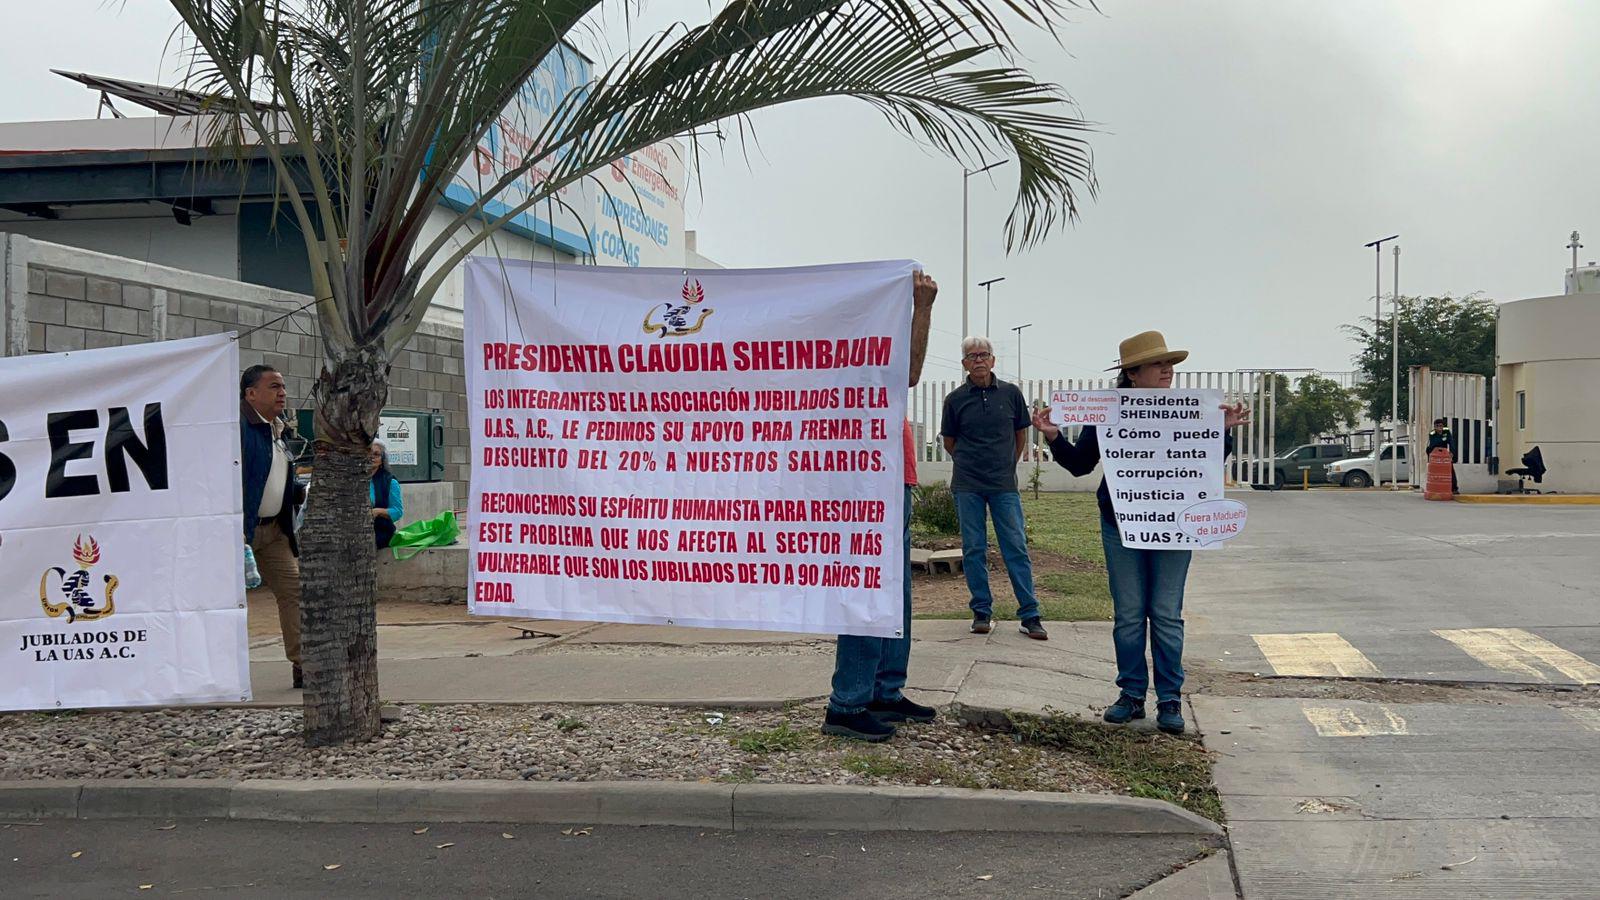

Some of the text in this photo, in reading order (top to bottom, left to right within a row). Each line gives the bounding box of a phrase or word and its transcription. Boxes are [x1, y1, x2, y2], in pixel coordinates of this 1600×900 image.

[602, 192, 669, 246] IMPRESIONES
[601, 230, 640, 267] COPIAS
[483, 336, 892, 373] PRESIDENTA CLAUDIA SHEINBAUM
[484, 387, 888, 412] LOS INTEGRANTES DE LA ASOCIACIÓN JUBILADOS DE LA
[1053, 393, 1079, 402] ALTO
[1120, 395, 1200, 407] Presidenta
[1063, 413, 1106, 423] SALARIO
[484, 418, 519, 440] U.A.S.,
[561, 420, 579, 439] LE
[586, 421, 655, 442] PEDIMOS
[663, 421, 684, 442] SU
[691, 421, 744, 442] APOYO
[752, 421, 792, 441] PARA
[800, 418, 863, 440] FRENAR
[871, 418, 887, 440] EL
[1173, 428, 1220, 442] puede
[45, 401, 169, 499] EN
[1105, 448, 1207, 459] tolerar tanta
[483, 447, 886, 473] DESCUENTO DEL 20% A NUESTROS SALARIOS.
[1116, 468, 1203, 481] corrupción,
[1116, 489, 1207, 503] injusticia e
[481, 492, 885, 523] RECONOCEMOS SU ESPÍRITU HUMANISTA PARA RESOLVER
[1116, 511, 1176, 524] punidad
[1184, 512, 1211, 523] Fuera
[1125, 531, 1135, 542] la
[1197, 523, 1238, 536] de la UAS
[479, 522, 882, 556] ESTE PROBLEMA QUE NOS AFECTA AL SECTOR MÁS
[477, 552, 881, 589] VULNERABLE QUE SON LOS JUBILADOS DE 70 A 90 AÑOS DE
[20, 630, 147, 651] JUBILADOS DE
[35, 646, 136, 662] LA UAS A.C.
